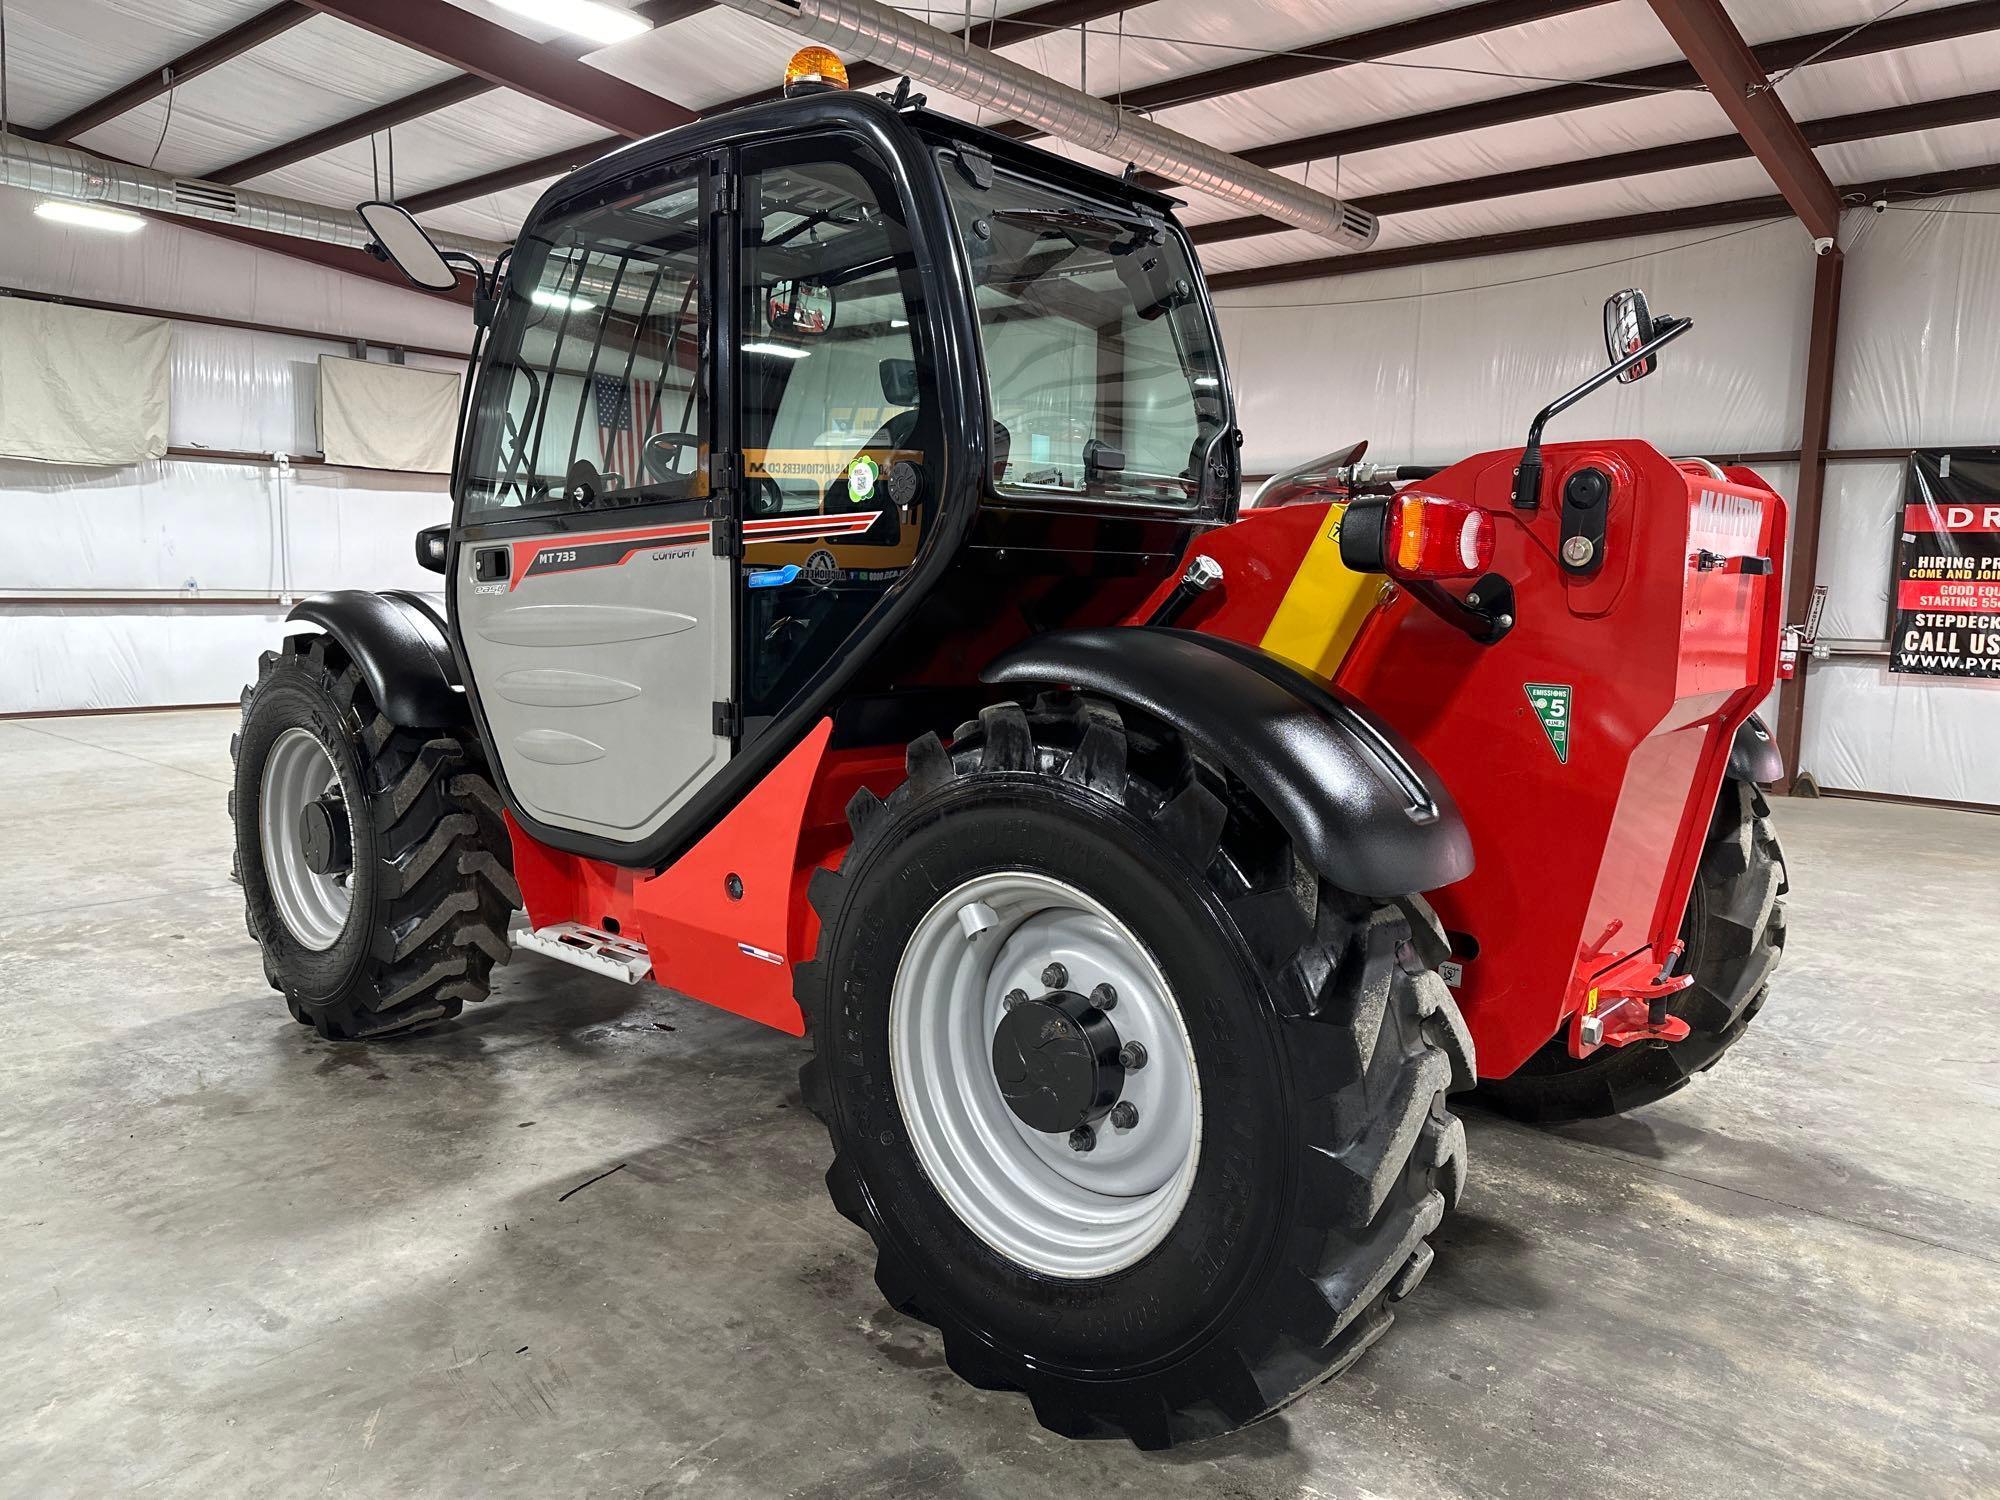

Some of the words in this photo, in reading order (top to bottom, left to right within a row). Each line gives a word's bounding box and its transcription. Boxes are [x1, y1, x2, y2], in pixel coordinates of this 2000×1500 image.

[1697, 489, 1763, 538] MANITOU
[1947, 507, 2000, 528] DR
[539, 553, 554, 564] MT
[556, 551, 577, 563] 733
[1918, 556, 1975, 569] HIRING
[1909, 568, 1942, 579] COME
[1946, 569, 1972, 579] AND
[474, 584, 507, 596] easy
[1940, 585, 1974, 596] GOOD
[1920, 595, 1978, 607] STARTING
[1915, 613, 2000, 630] STEPDECK
[1904, 630, 1960, 653] CALL
[1969, 633, 2000, 656] US
[1549, 698, 1566, 718] 5
